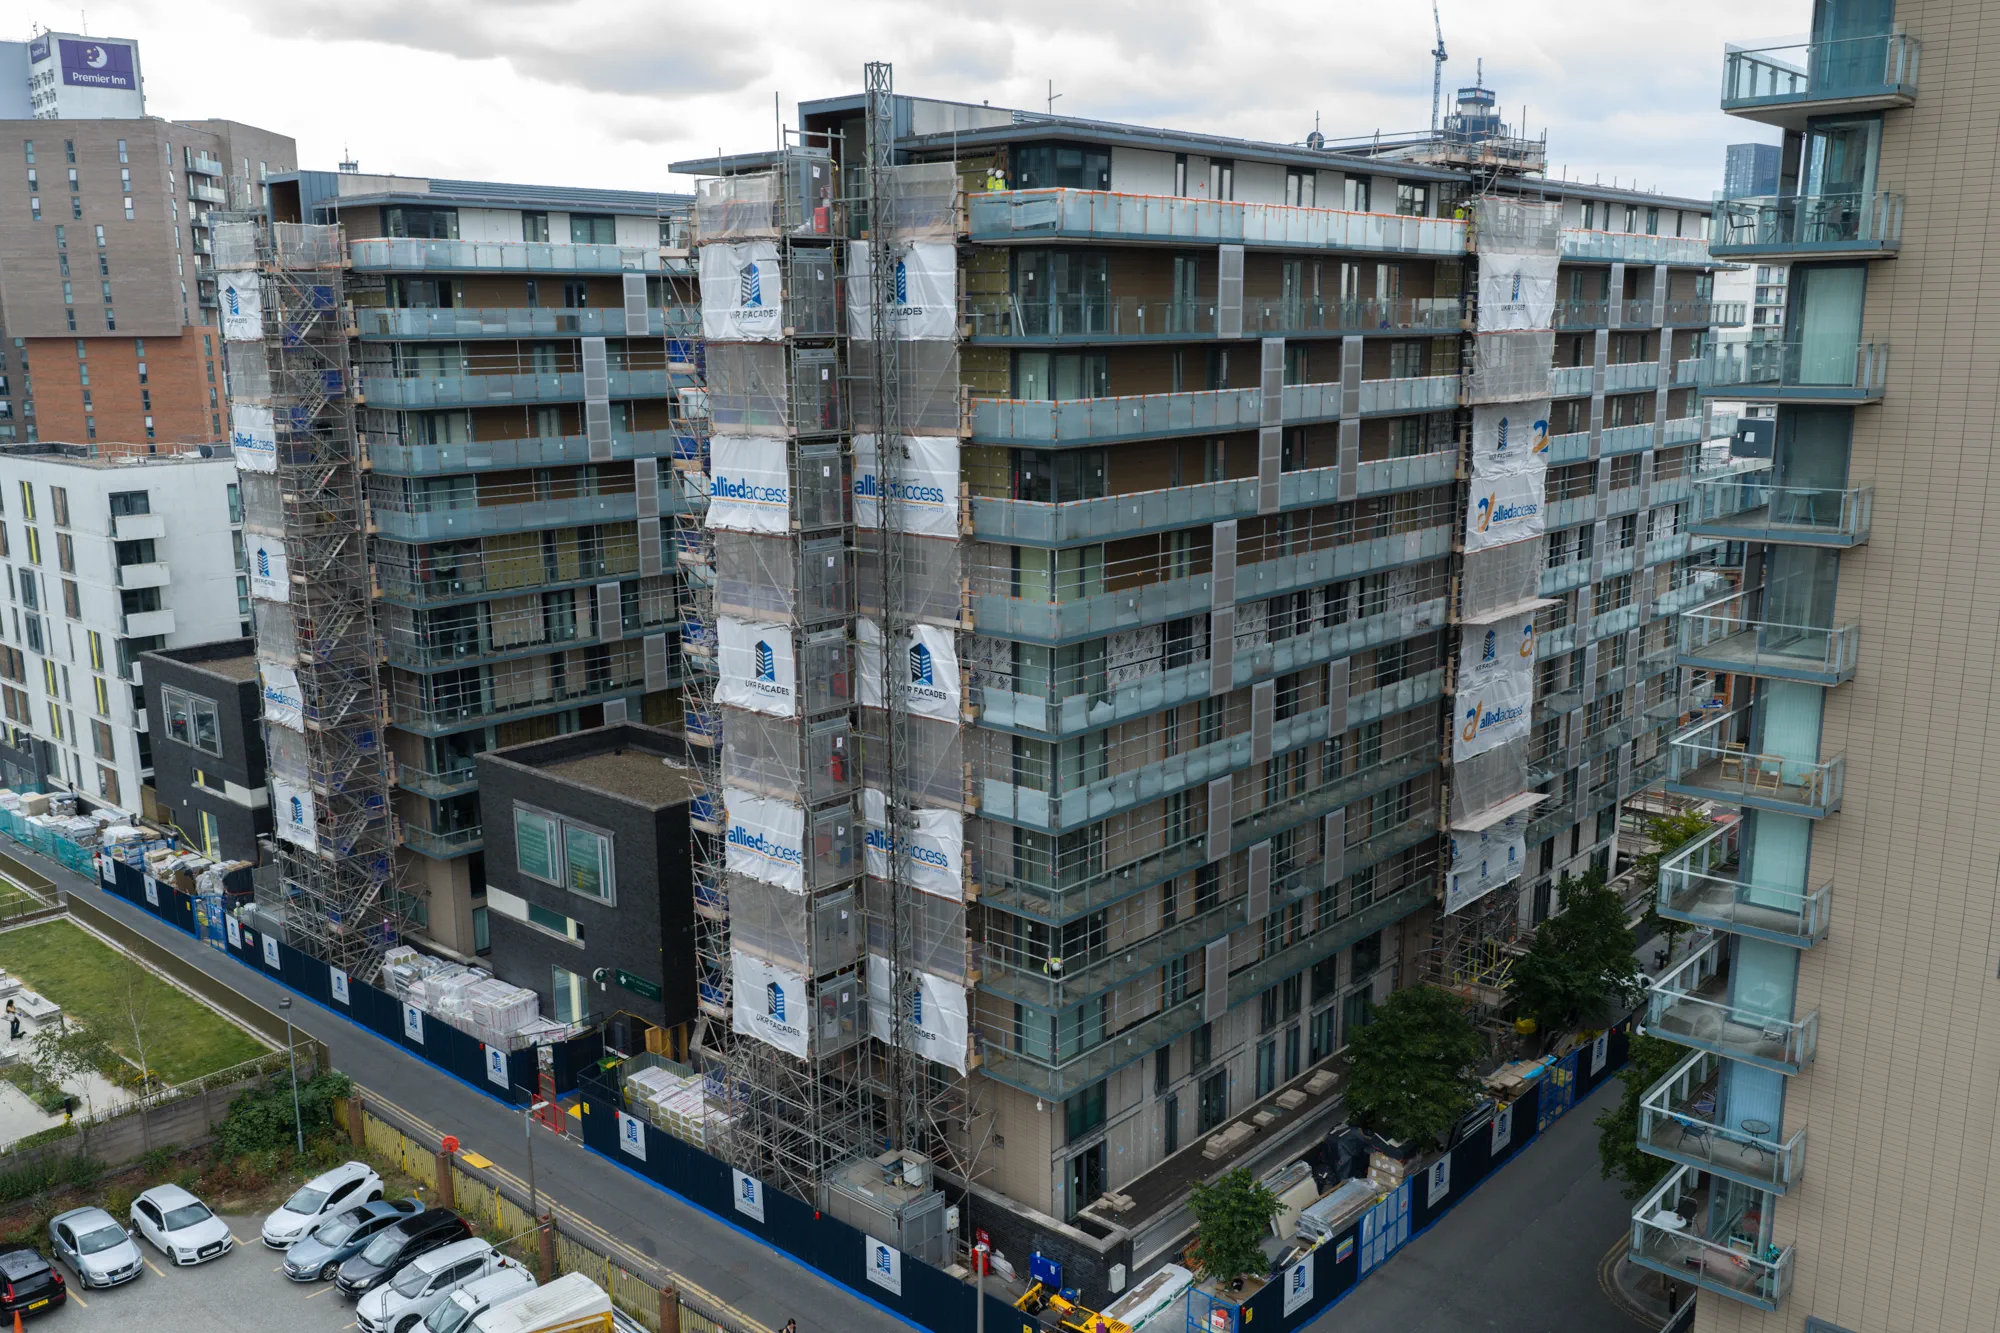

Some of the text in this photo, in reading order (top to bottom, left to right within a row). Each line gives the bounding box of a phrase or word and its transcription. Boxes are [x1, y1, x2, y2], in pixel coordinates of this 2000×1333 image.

[72, 72, 126, 85] Premier Inn
[742, 309, 778, 319] FACADES
[1492, 502, 1537, 523] alliedaccess
[745, 680, 790, 696] UKR FACADES
[913, 686, 947, 700] FACADES
[728, 825, 802, 865] alliedaccess
[865, 829, 948, 868] allieccess
[756, 1013, 800, 1037] UKR FACADES
